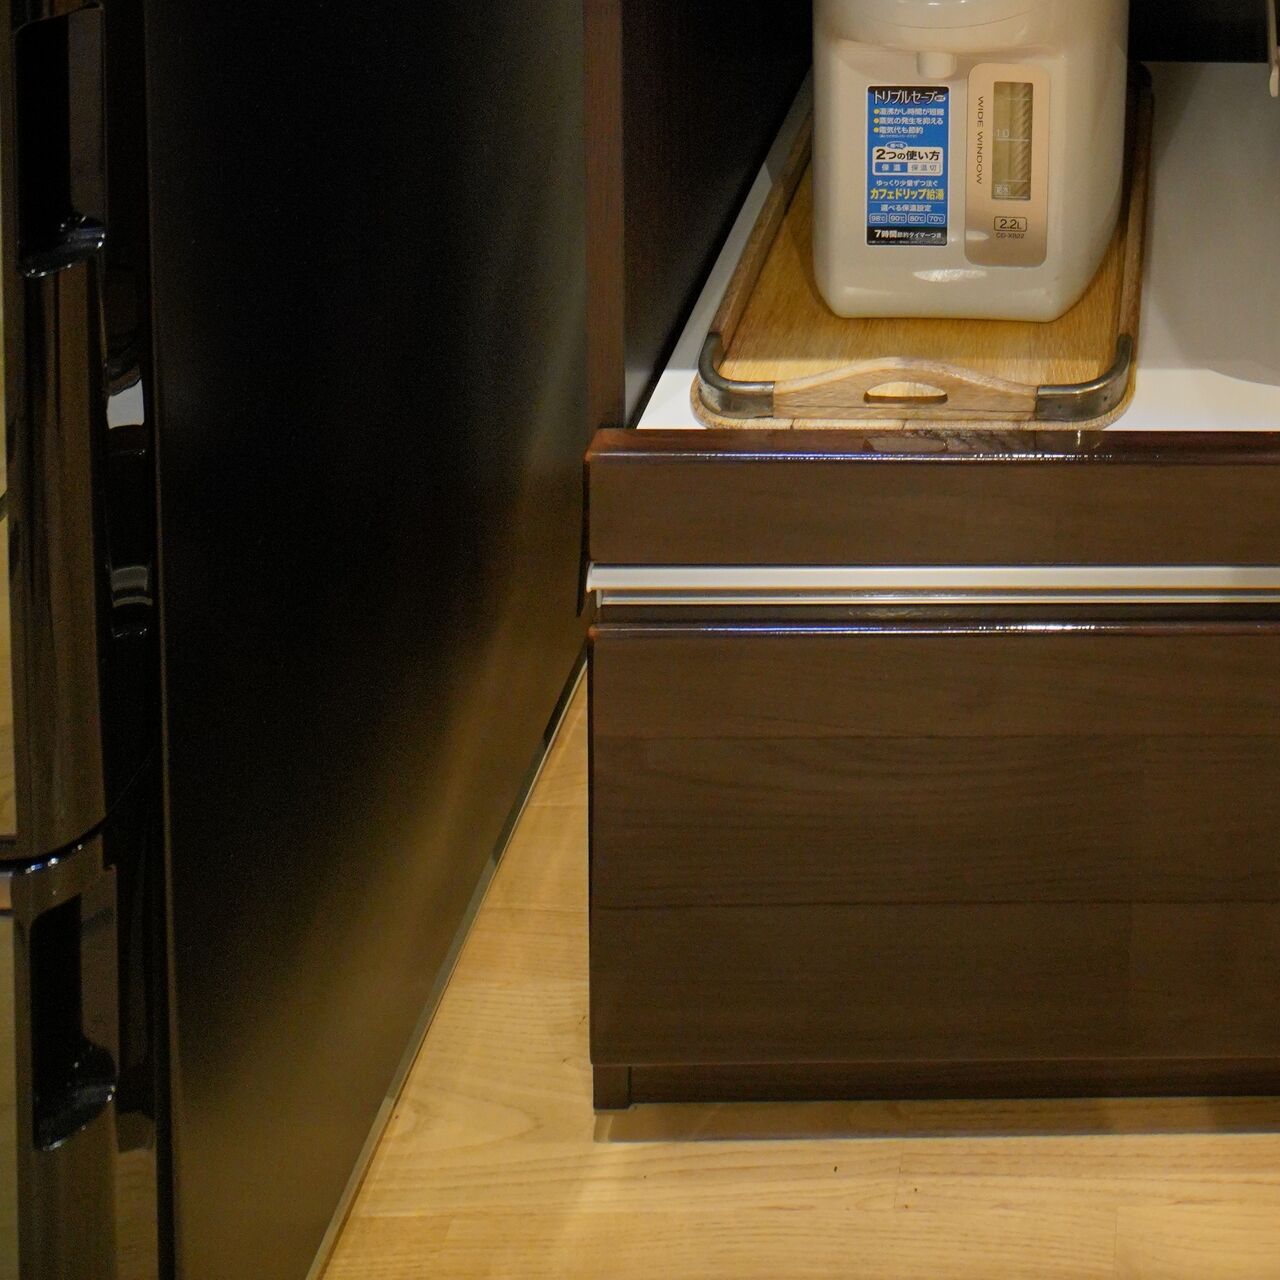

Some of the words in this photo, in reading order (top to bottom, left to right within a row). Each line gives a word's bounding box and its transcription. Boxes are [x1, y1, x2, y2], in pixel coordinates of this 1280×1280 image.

[874, 89, 938, 105] トリプルセーブ
[976, 95, 984, 127] WIDE
[875, 148, 940, 161] 2つの使い方
[975, 131, 984, 184] WINDOW
[870, 188, 945, 200] カフェドリップ給湯
[1000, 219, 1022, 230] 2.2L
